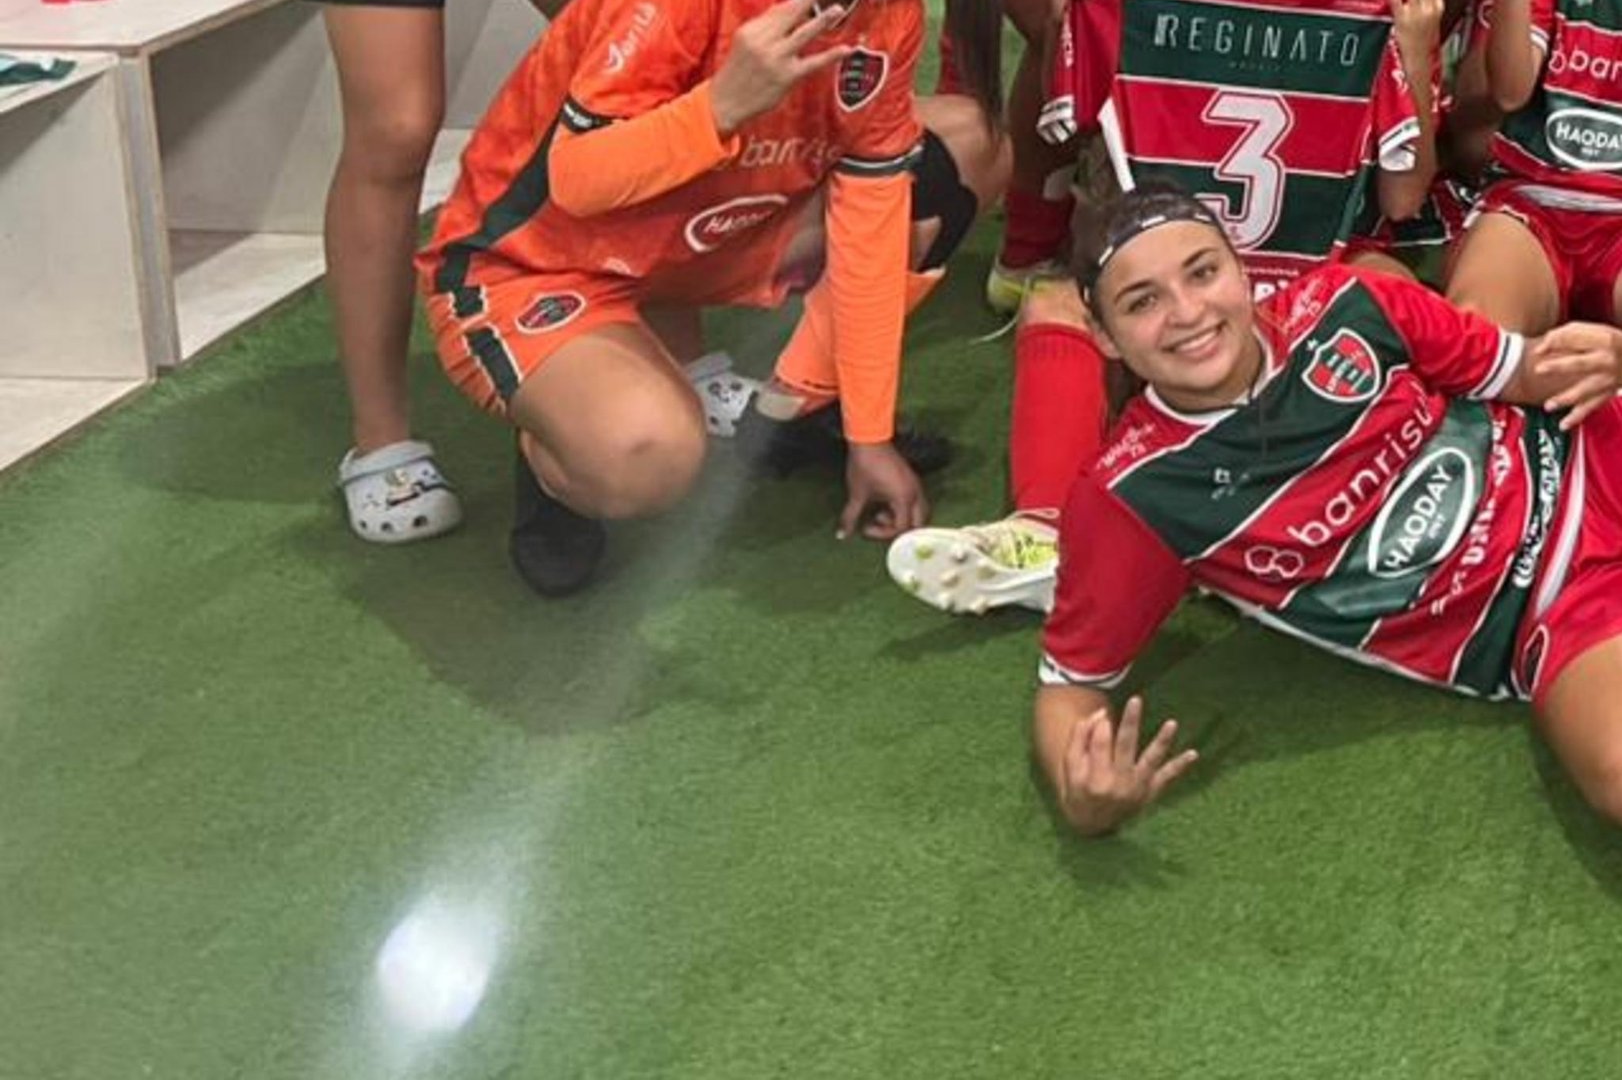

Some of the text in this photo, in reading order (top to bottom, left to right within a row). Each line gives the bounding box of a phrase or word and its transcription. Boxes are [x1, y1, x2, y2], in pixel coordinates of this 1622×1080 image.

[1153, 13, 1361, 66] REGINATO
[1201, 86, 1294, 251] 3
[1384, 464, 1454, 569] HAODAY
